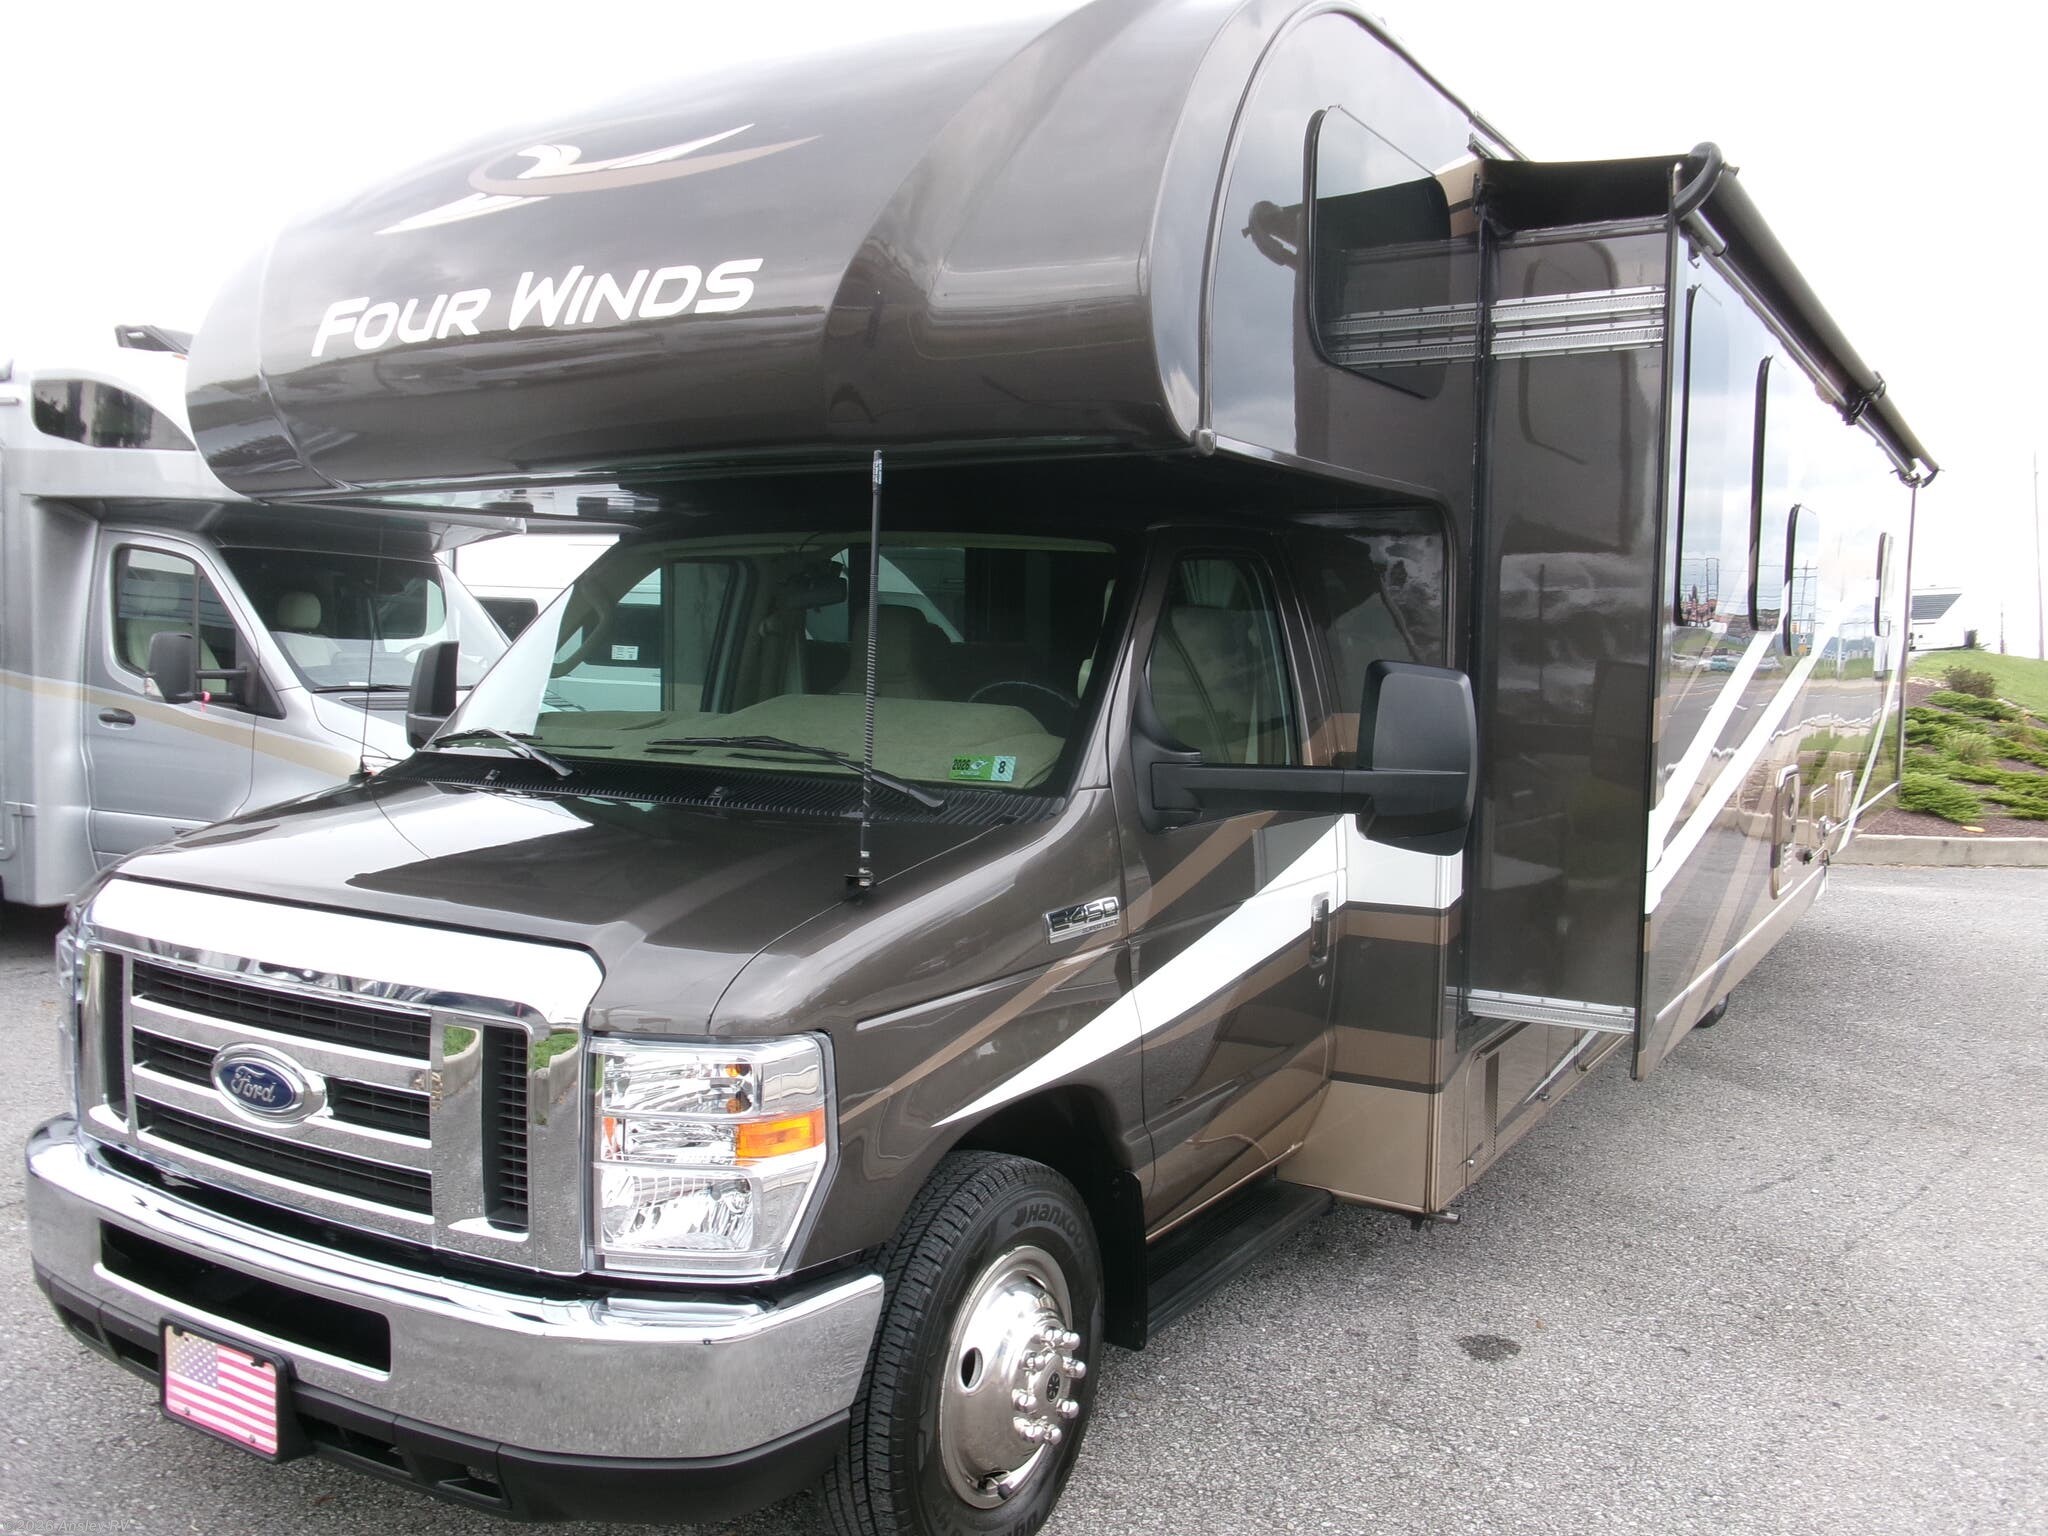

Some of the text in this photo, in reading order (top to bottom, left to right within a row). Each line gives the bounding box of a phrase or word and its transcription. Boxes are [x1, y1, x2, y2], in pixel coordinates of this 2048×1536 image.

[311, 257, 764, 358] FOUR WINDS
[952, 758, 971, 771] 2026
[997, 760, 1007, 774] 8
[1048, 899, 1118, 932] E-450
[230, 1065, 277, 1103] Ford
